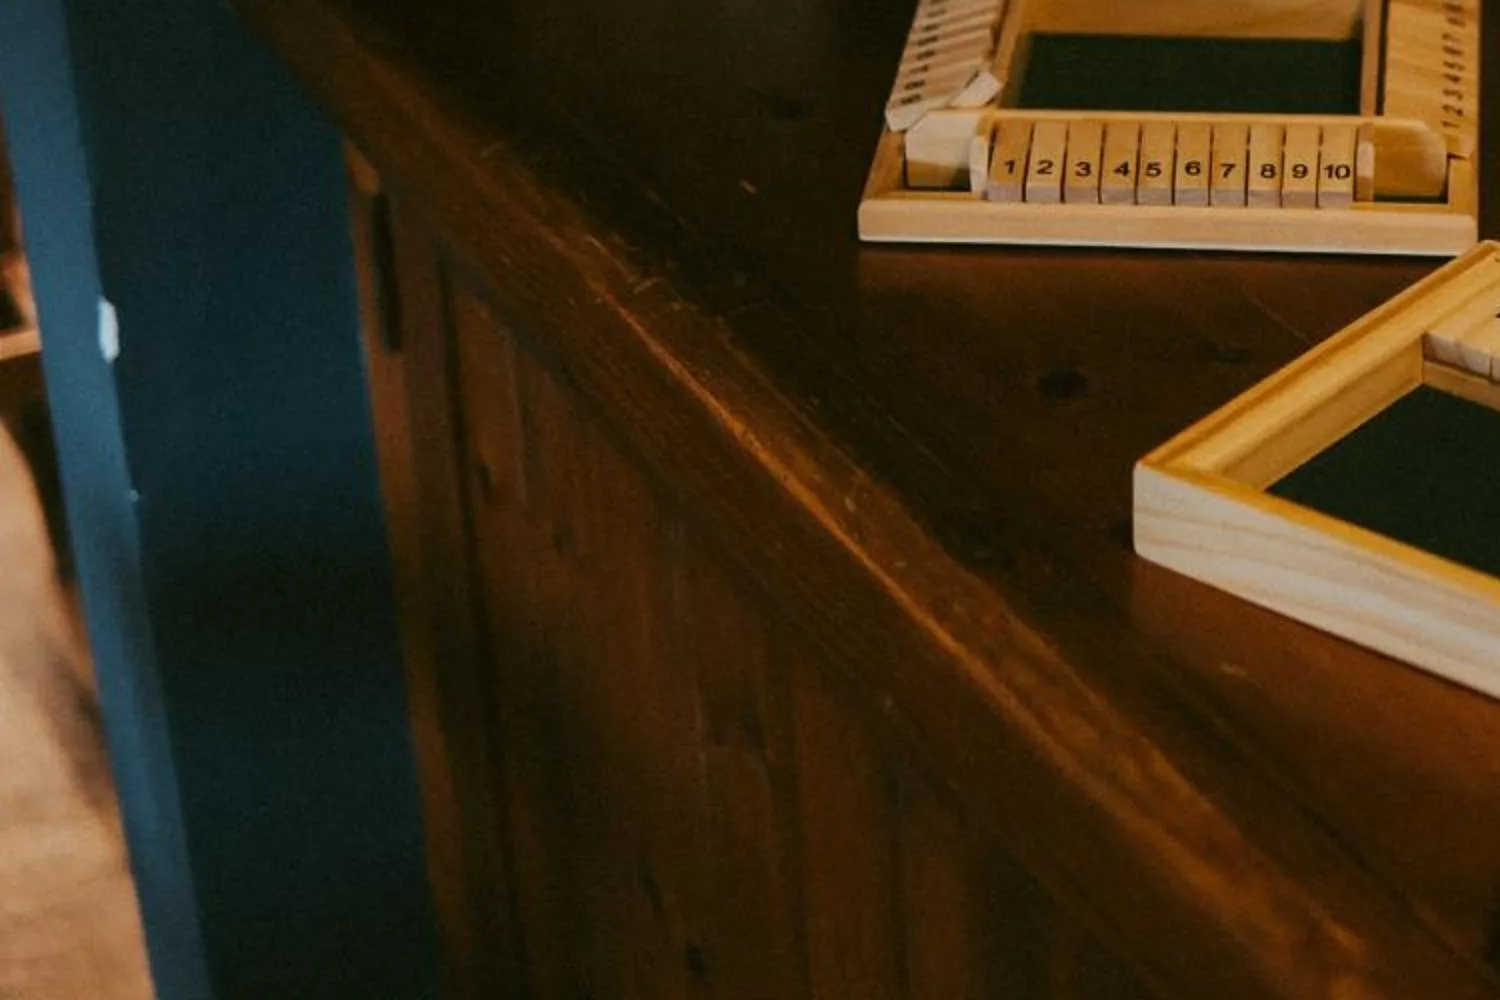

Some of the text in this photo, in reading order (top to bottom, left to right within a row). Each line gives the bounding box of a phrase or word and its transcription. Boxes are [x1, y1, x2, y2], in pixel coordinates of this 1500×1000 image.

[1005, 159, 1351, 180] 1 2 3 4 5 6 7 8 9 10
